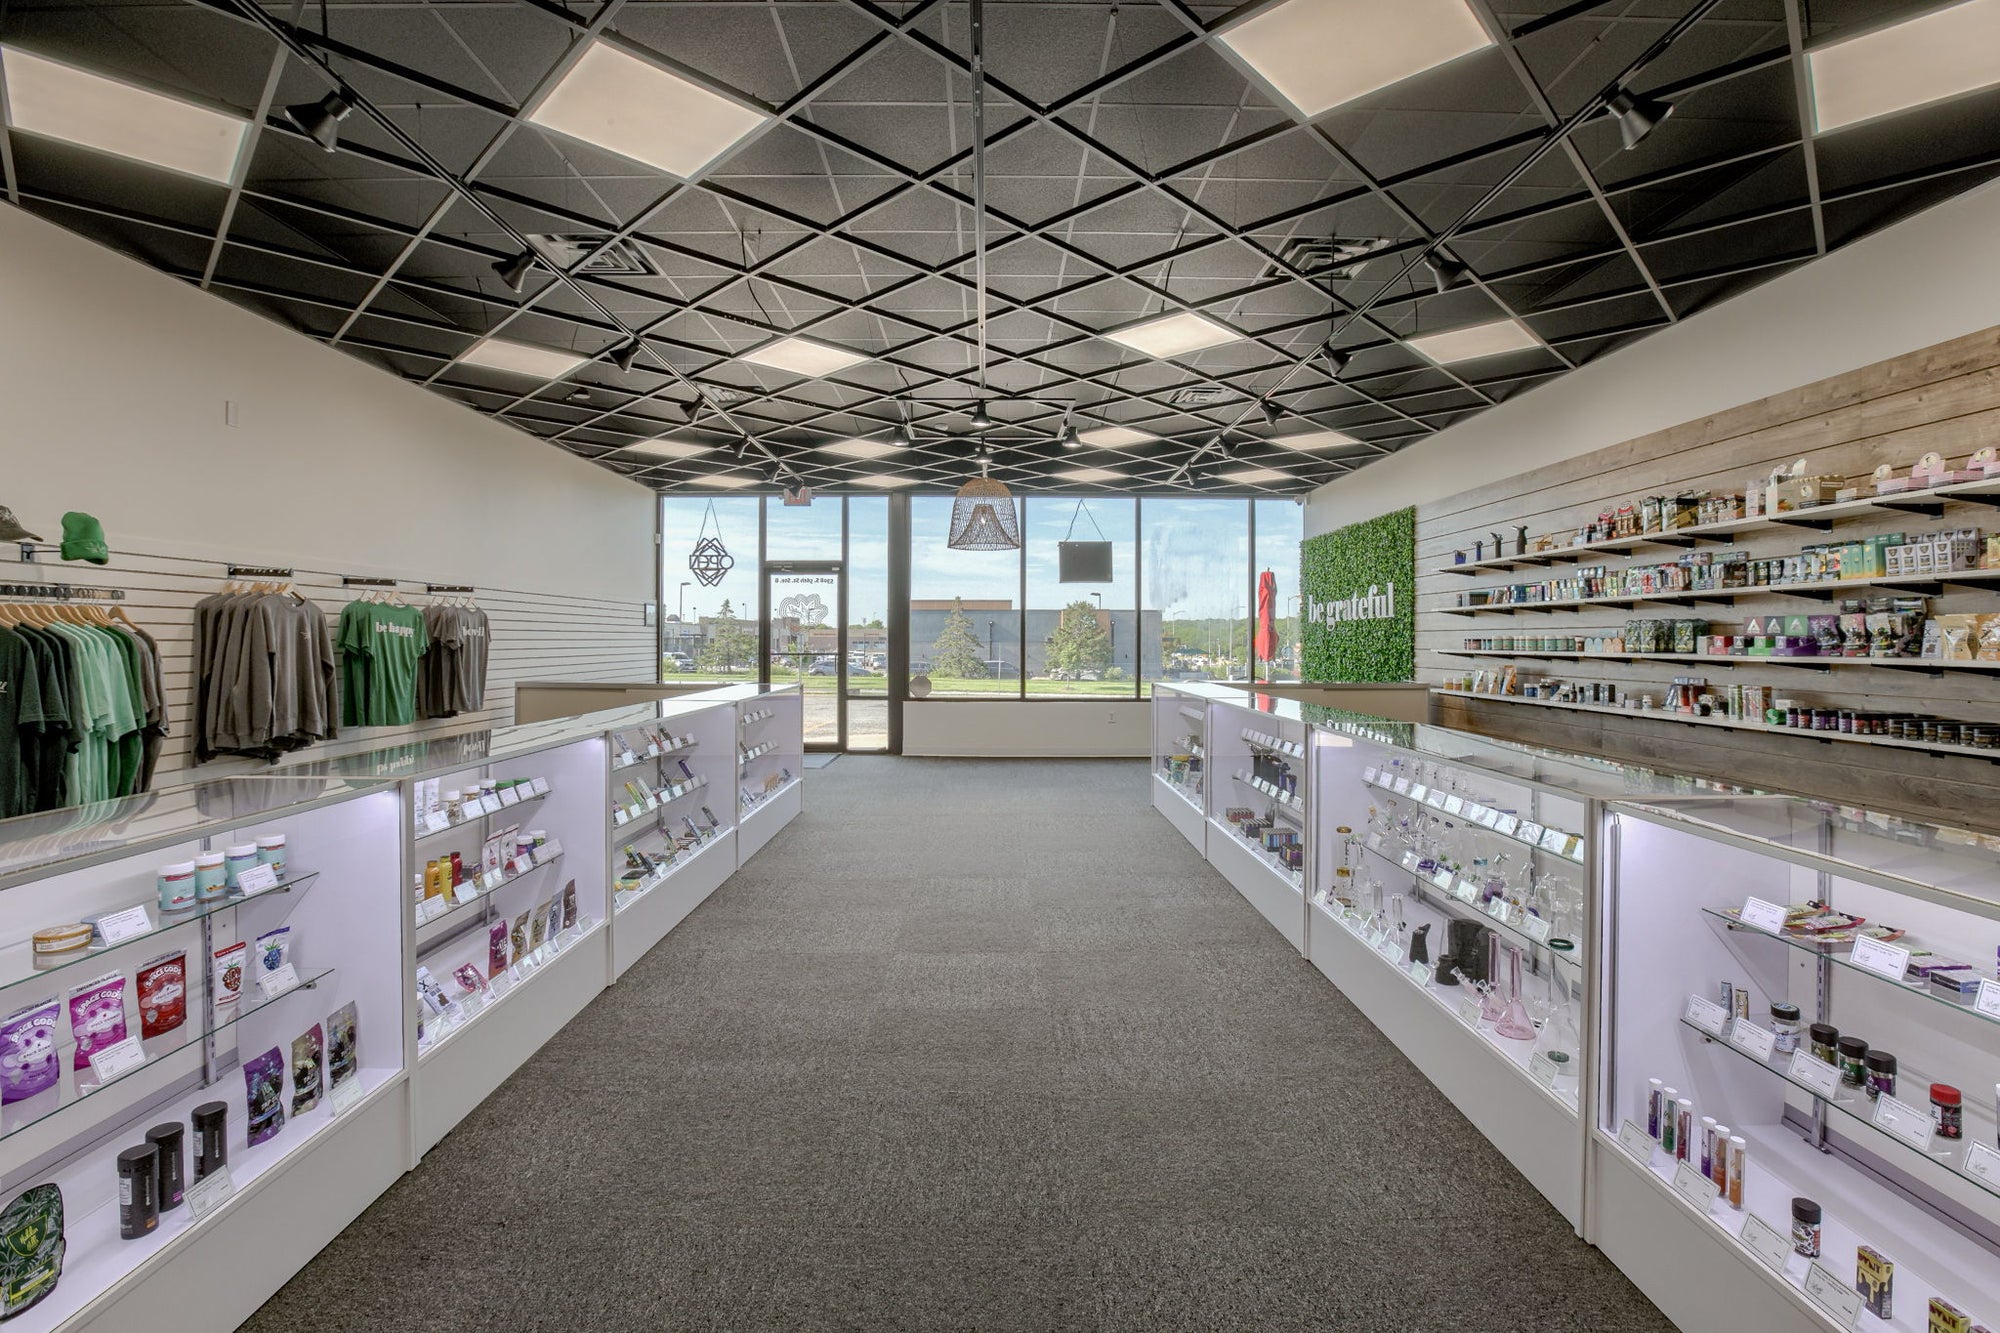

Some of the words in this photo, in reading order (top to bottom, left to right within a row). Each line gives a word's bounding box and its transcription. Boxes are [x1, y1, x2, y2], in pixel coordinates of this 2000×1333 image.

[1308, 594, 1324, 624] be
[1326, 582, 1395, 632] grateful
[375, 621, 387, 633] be
[389, 622, 415, 638] happy
[145, 967, 165, 988] SPACE
[163, 965, 181, 975] GODS
[77, 992, 101, 1016] SPACE
[100, 990, 122, 1000] GODS
[10, 1020, 34, 1043] SPACE
